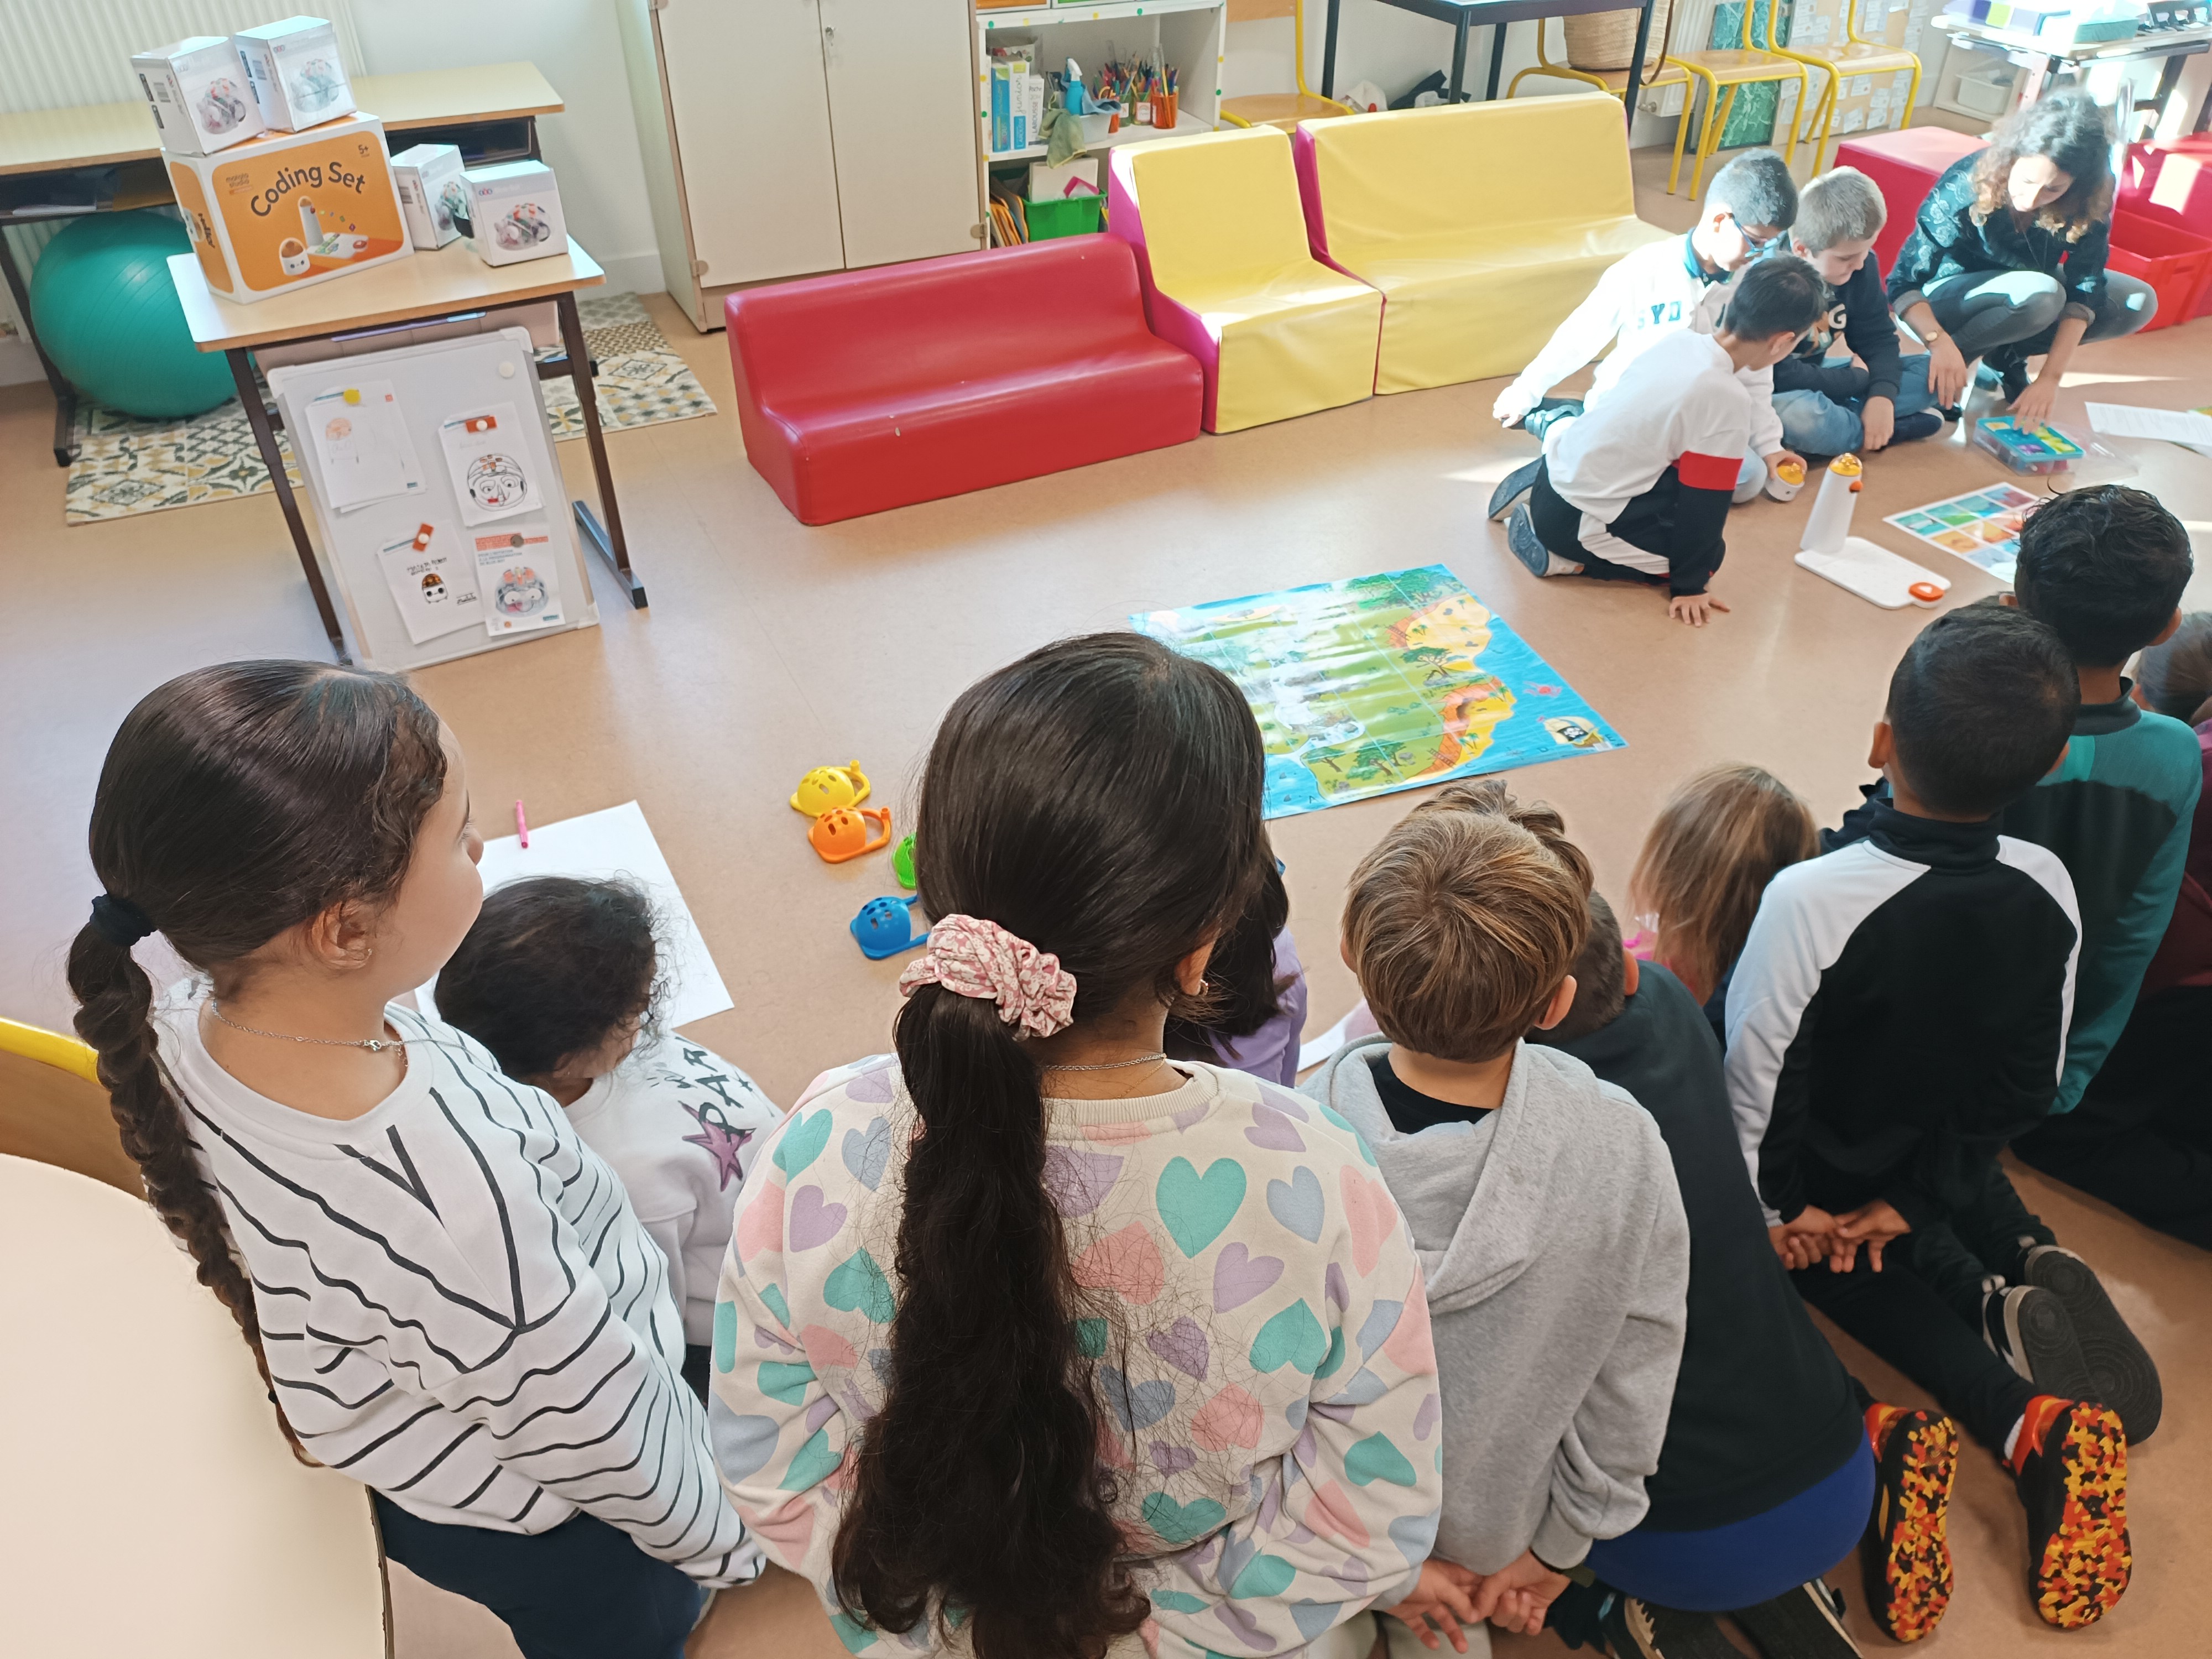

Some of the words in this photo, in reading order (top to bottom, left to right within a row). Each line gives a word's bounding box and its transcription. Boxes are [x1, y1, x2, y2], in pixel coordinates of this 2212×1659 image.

[1014, 75, 1027, 114] junior
[358, 144, 368, 154] 5+
[251, 166, 323, 217] Coding
[328, 161, 366, 194] Set
